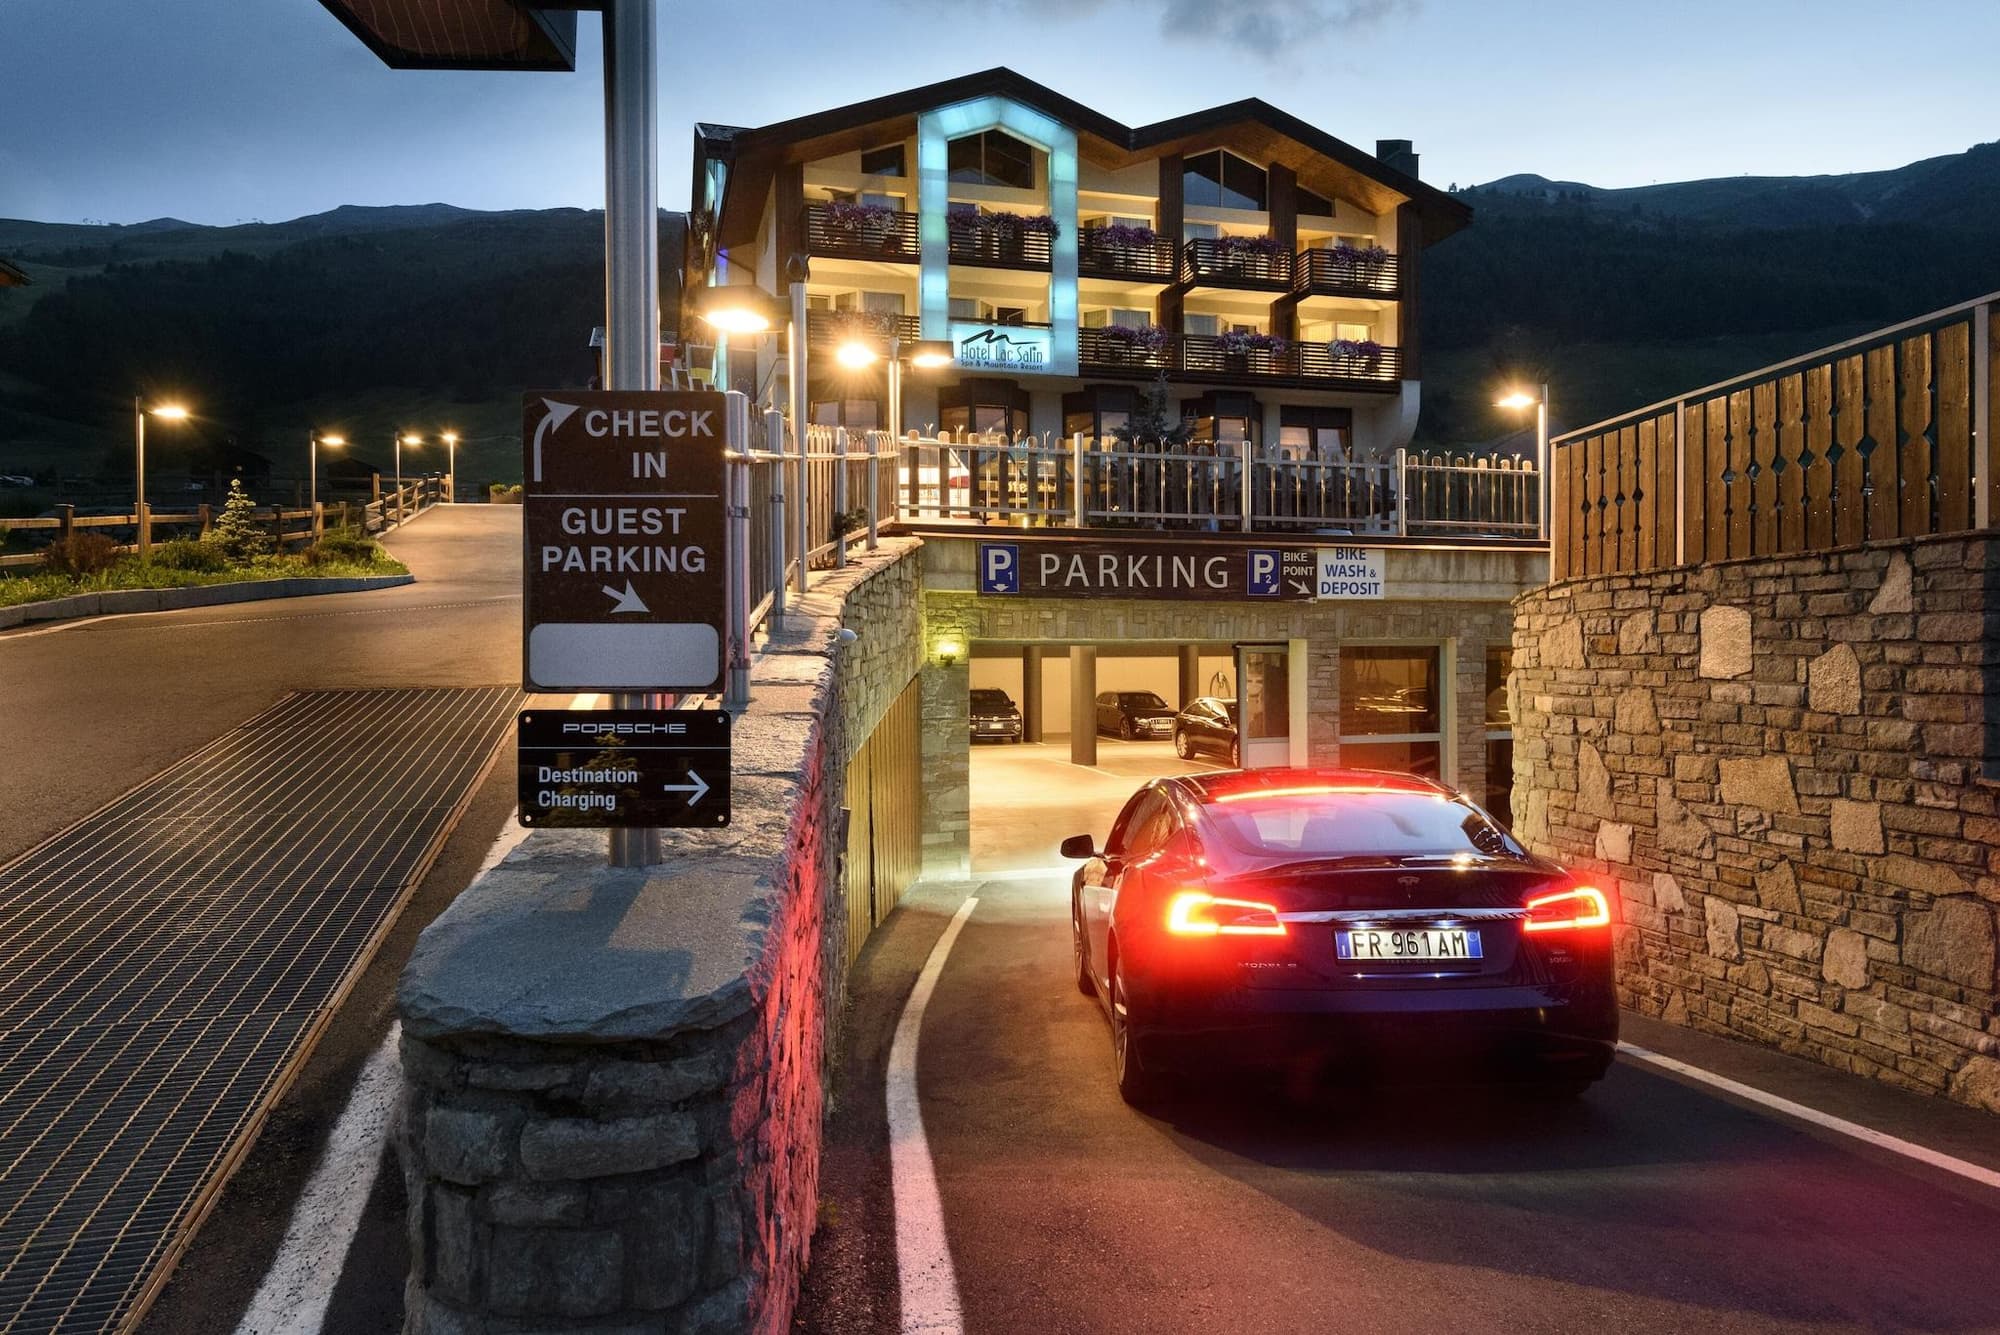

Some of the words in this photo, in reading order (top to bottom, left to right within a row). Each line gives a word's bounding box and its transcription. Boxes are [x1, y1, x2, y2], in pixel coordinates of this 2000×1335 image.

[961, 343, 990, 360] Hotel
[996, 345, 1013, 361] Lac
[1017, 345, 1043, 363] Salin
[584, 410, 714, 437] CHECK
[632, 452, 667, 478] IN
[561, 507, 687, 535] GUEST
[542, 546, 706, 572] PARKING
[1283, 552, 1308, 562] BIKE
[1336, 548, 1366, 560] BIKE
[1040, 553, 1228, 588] PARKING
[1283, 566, 1315, 576] POINT
[1325, 564, 1366, 577] WASH
[1369, 569, 1377, 577] &
[1321, 582, 1380, 594] DEPOSIT
[563, 723, 686, 733] PORSCHE
[538, 766, 638, 783] Destination
[538, 790, 616, 811] Charging
